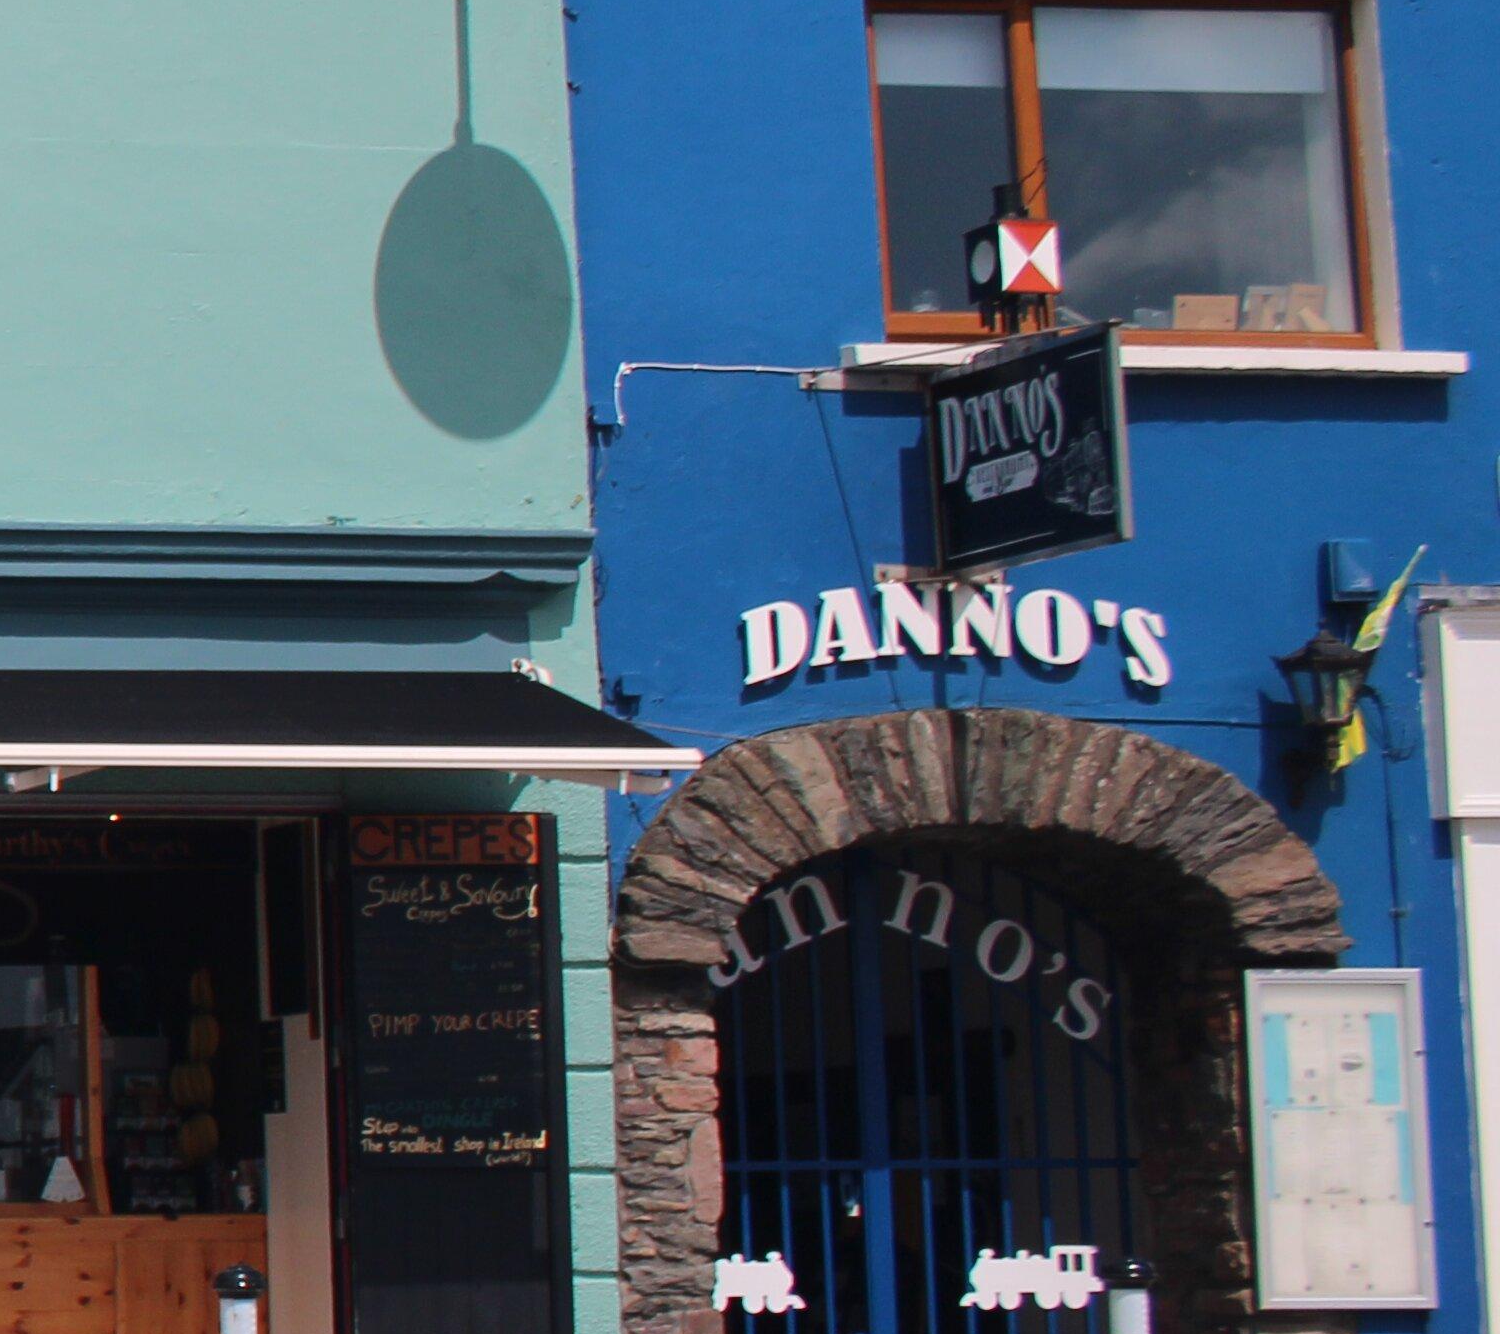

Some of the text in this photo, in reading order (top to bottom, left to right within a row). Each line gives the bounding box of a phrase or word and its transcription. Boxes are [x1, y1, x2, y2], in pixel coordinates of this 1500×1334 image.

[740, 579, 1174, 688] DANNO'S
[353, 818, 535, 861] CREPES
[361, 875, 434, 917] Sweet
[450, 873, 539, 921] Savoury
[706, 869, 1112, 1040] anno's
[368, 1007, 541, 1039] PIMP YOUR CREPE
[360, 1137, 385, 1154] The
[388, 1136, 445, 1155] smallest
[453, 1136, 486, 1156] shop
[501, 1128, 549, 1151] Ireland
